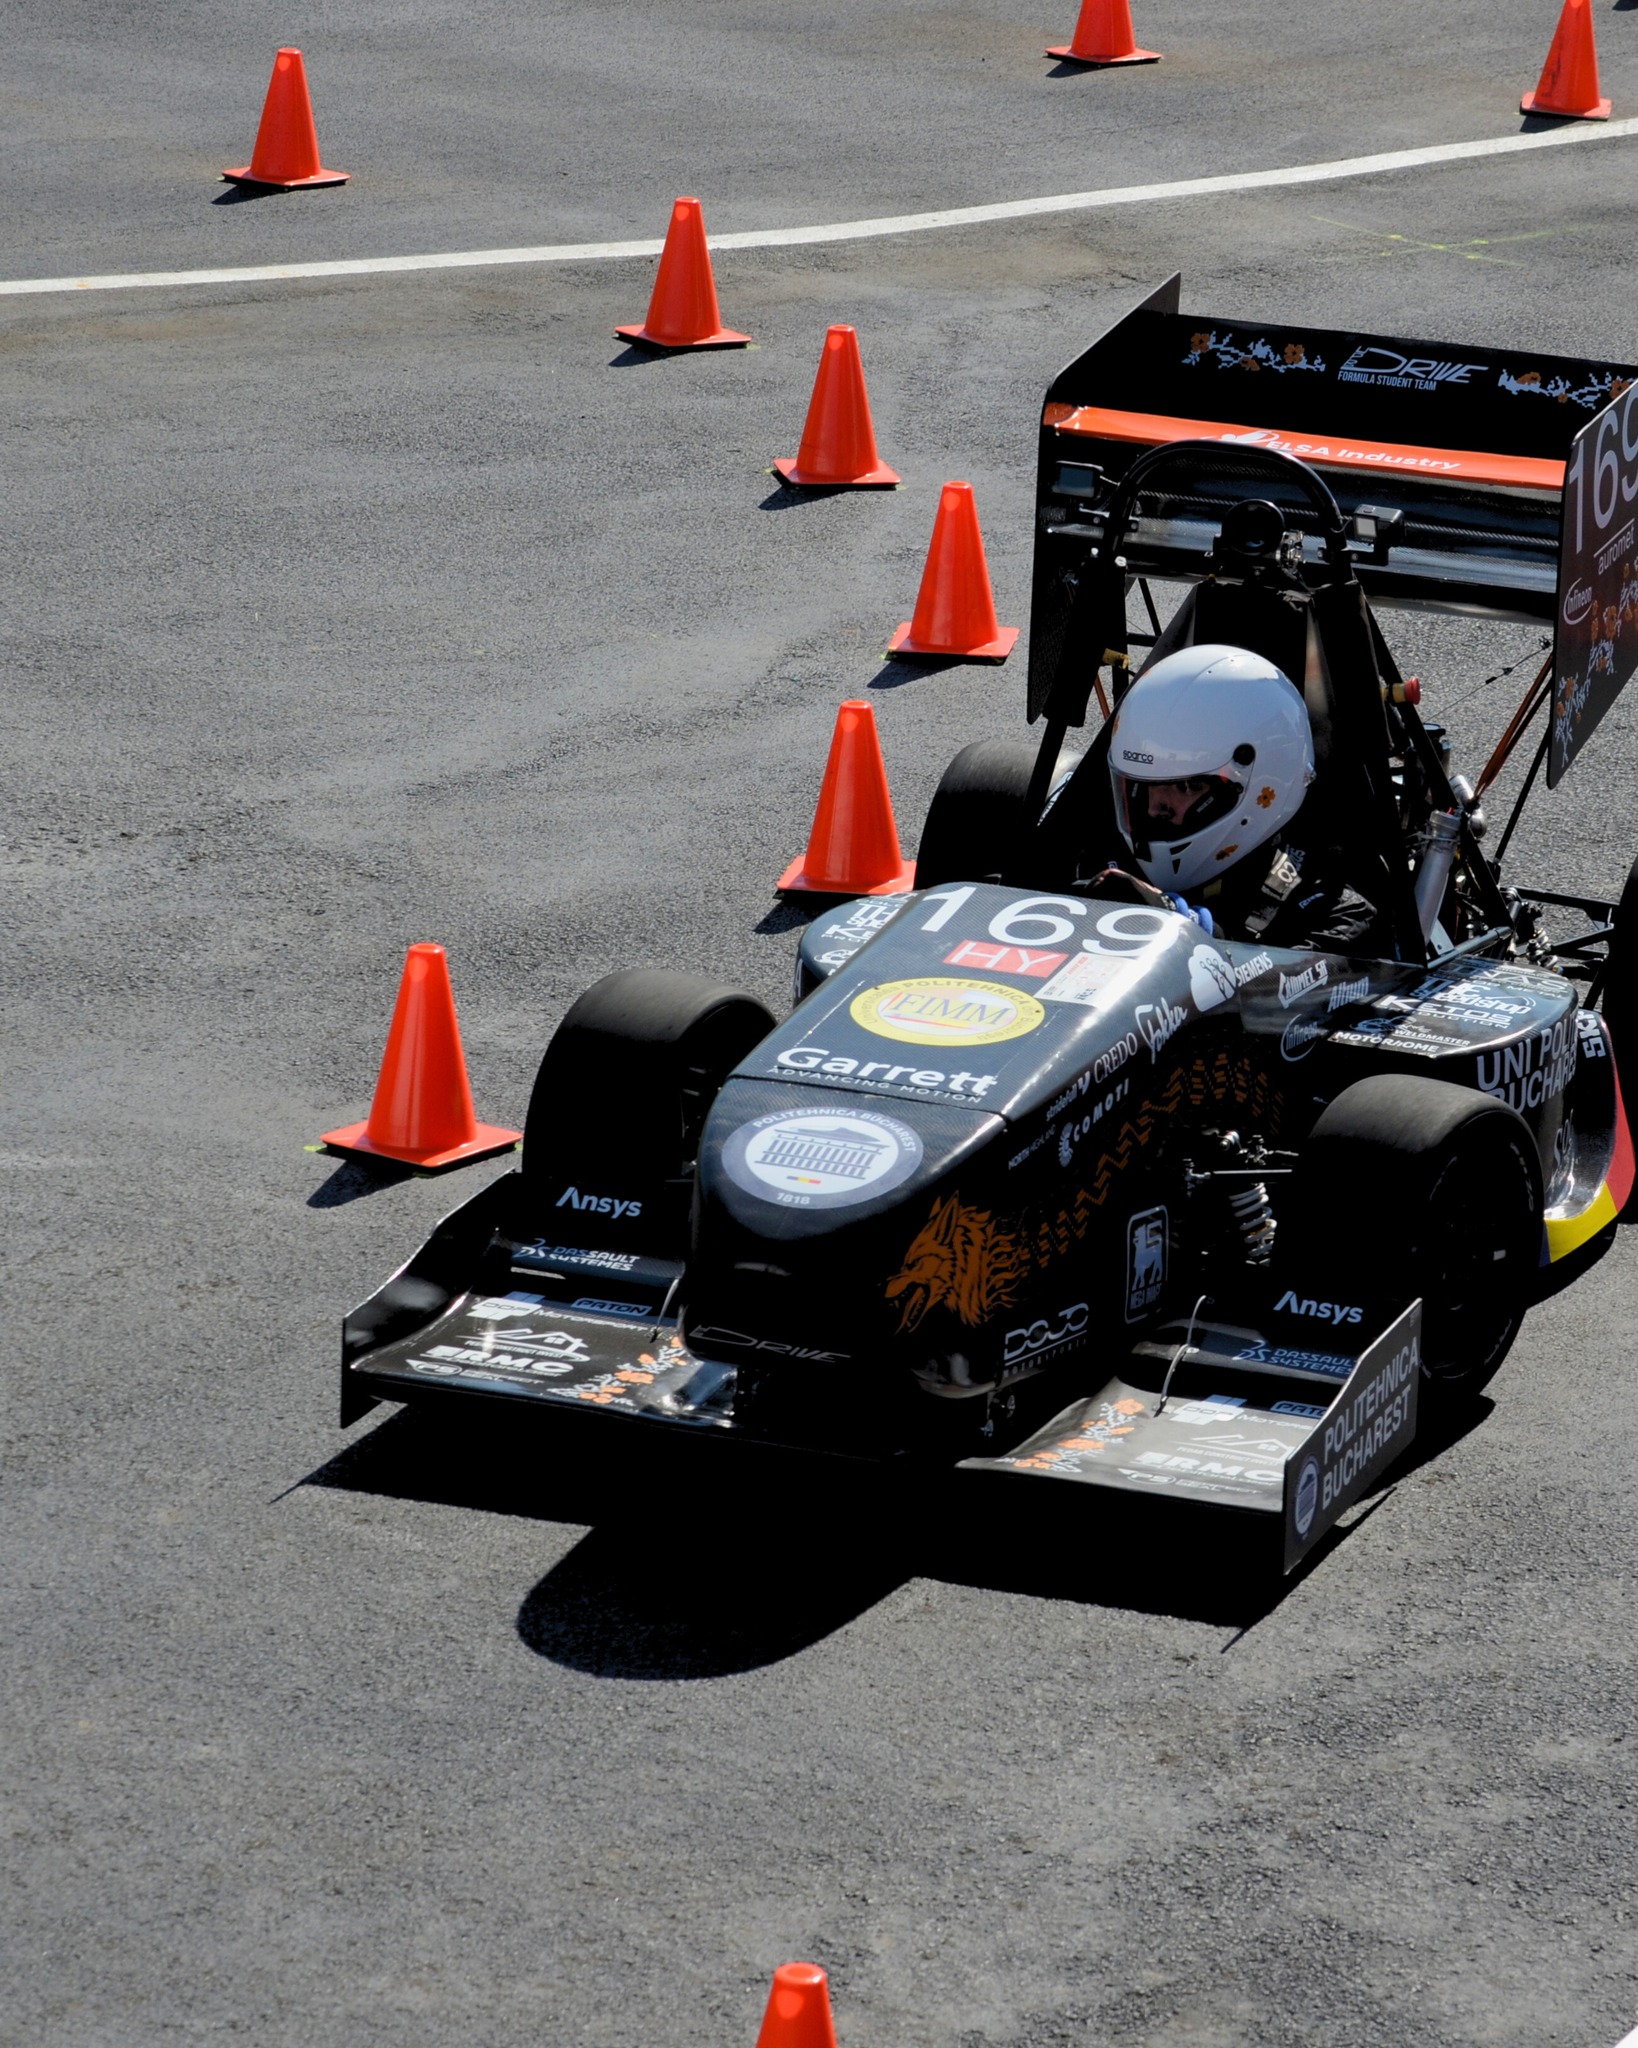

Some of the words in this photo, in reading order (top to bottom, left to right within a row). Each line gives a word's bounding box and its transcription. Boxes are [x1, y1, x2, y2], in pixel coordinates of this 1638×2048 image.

[1337, 371, 1374, 384] FORMULA
[1376, 374, 1412, 388] STUDENT
[1414, 379, 1438, 391] TEAM
[1340, 346, 1489, 383] DRIVE
[1337, 448, 1461, 470] Industry
[1123, 750, 1154, 763] sparco
[920, 886, 1180, 957] 169
[950, 942, 1061, 973] HY
[1234, 952, 1274, 988] SIEMENS
[891, 992, 1013, 1025] FIMM
[902, 980, 1027, 1005] POLITEHNICA
[1380, 994, 1513, 1025] KETOS
[1394, 1030, 1471, 1046] WELDMASTER
[776, 1047, 998, 1096] Garrett
[1094, 1032, 1138, 1084] CREDO
[1476, 1038, 1532, 1092] UNI
[766, 1068, 891, 1090] ADVANCING
[900, 1085, 984, 1104] MOTION
[1074, 1078, 1130, 1142] COMOTI
[753, 1109, 857, 1128] POLITEHNICA
[859, 1112, 917, 1152] BUCHAREST
[555, 1186, 642, 1219] Ansys
[776, 1192, 811, 1205] 1818
[552, 1246, 641, 1265] DASSAULT
[577, 1299, 647, 1315] PATON
[1272, 1290, 1364, 1325] Ansys
[1003, 1302, 1089, 1361] DOJO
[463, 1349, 574, 1374] RMC
[1324, 1336, 1419, 1465] POLITEHNICA
[1322, 1384, 1412, 1511] BUCHAREST
[1163, 1456, 1285, 1482] RMC
